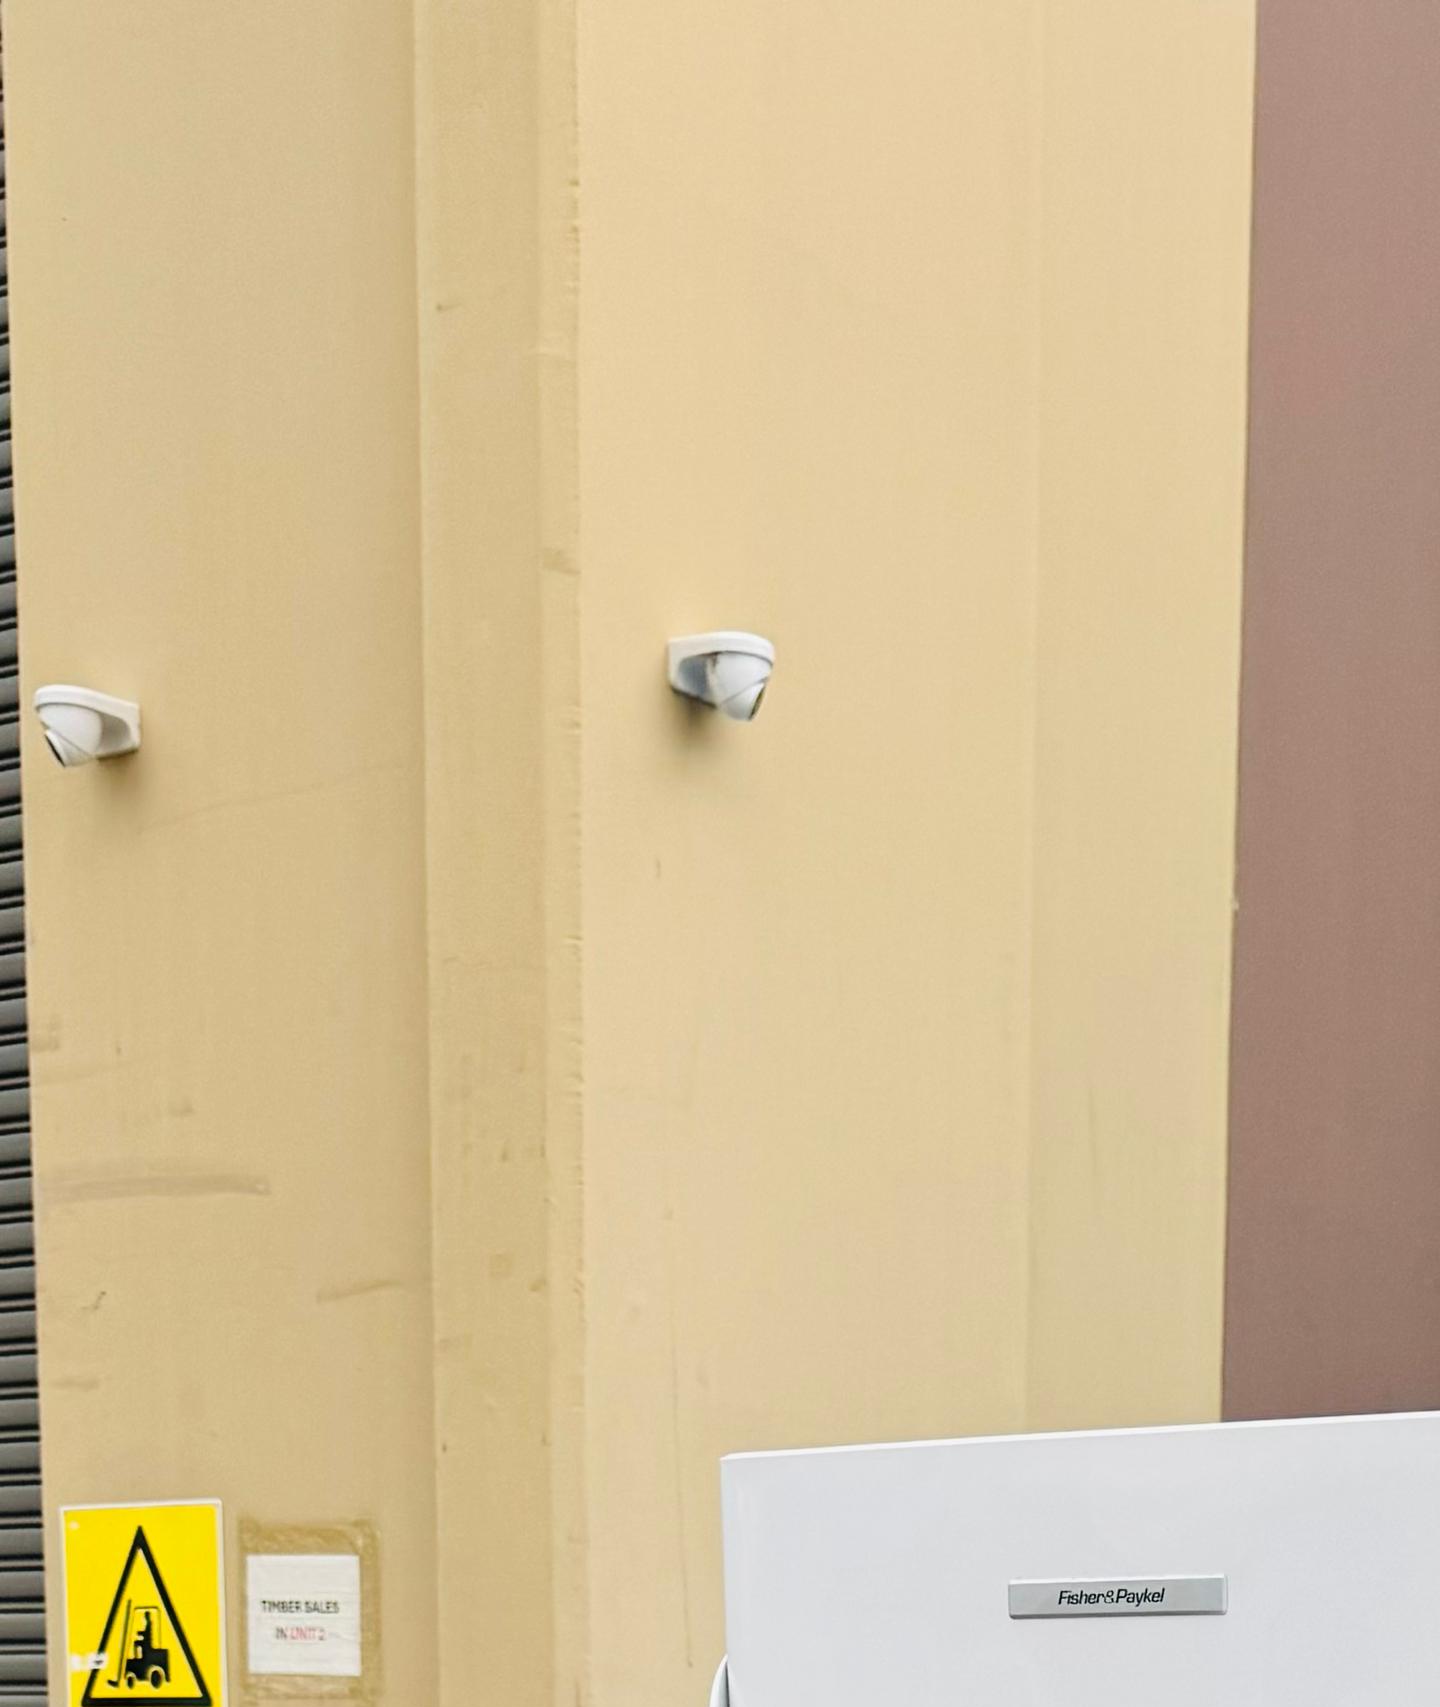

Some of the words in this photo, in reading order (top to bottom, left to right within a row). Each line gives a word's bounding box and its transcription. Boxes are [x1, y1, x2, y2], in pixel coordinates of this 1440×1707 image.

[1058, 1587, 1165, 1607] Fisher&Paykel
[261, 1600, 302, 1614] TIMBER
[305, 1600, 340, 1614] SALES
[275, 1627, 287, 1640] IN
